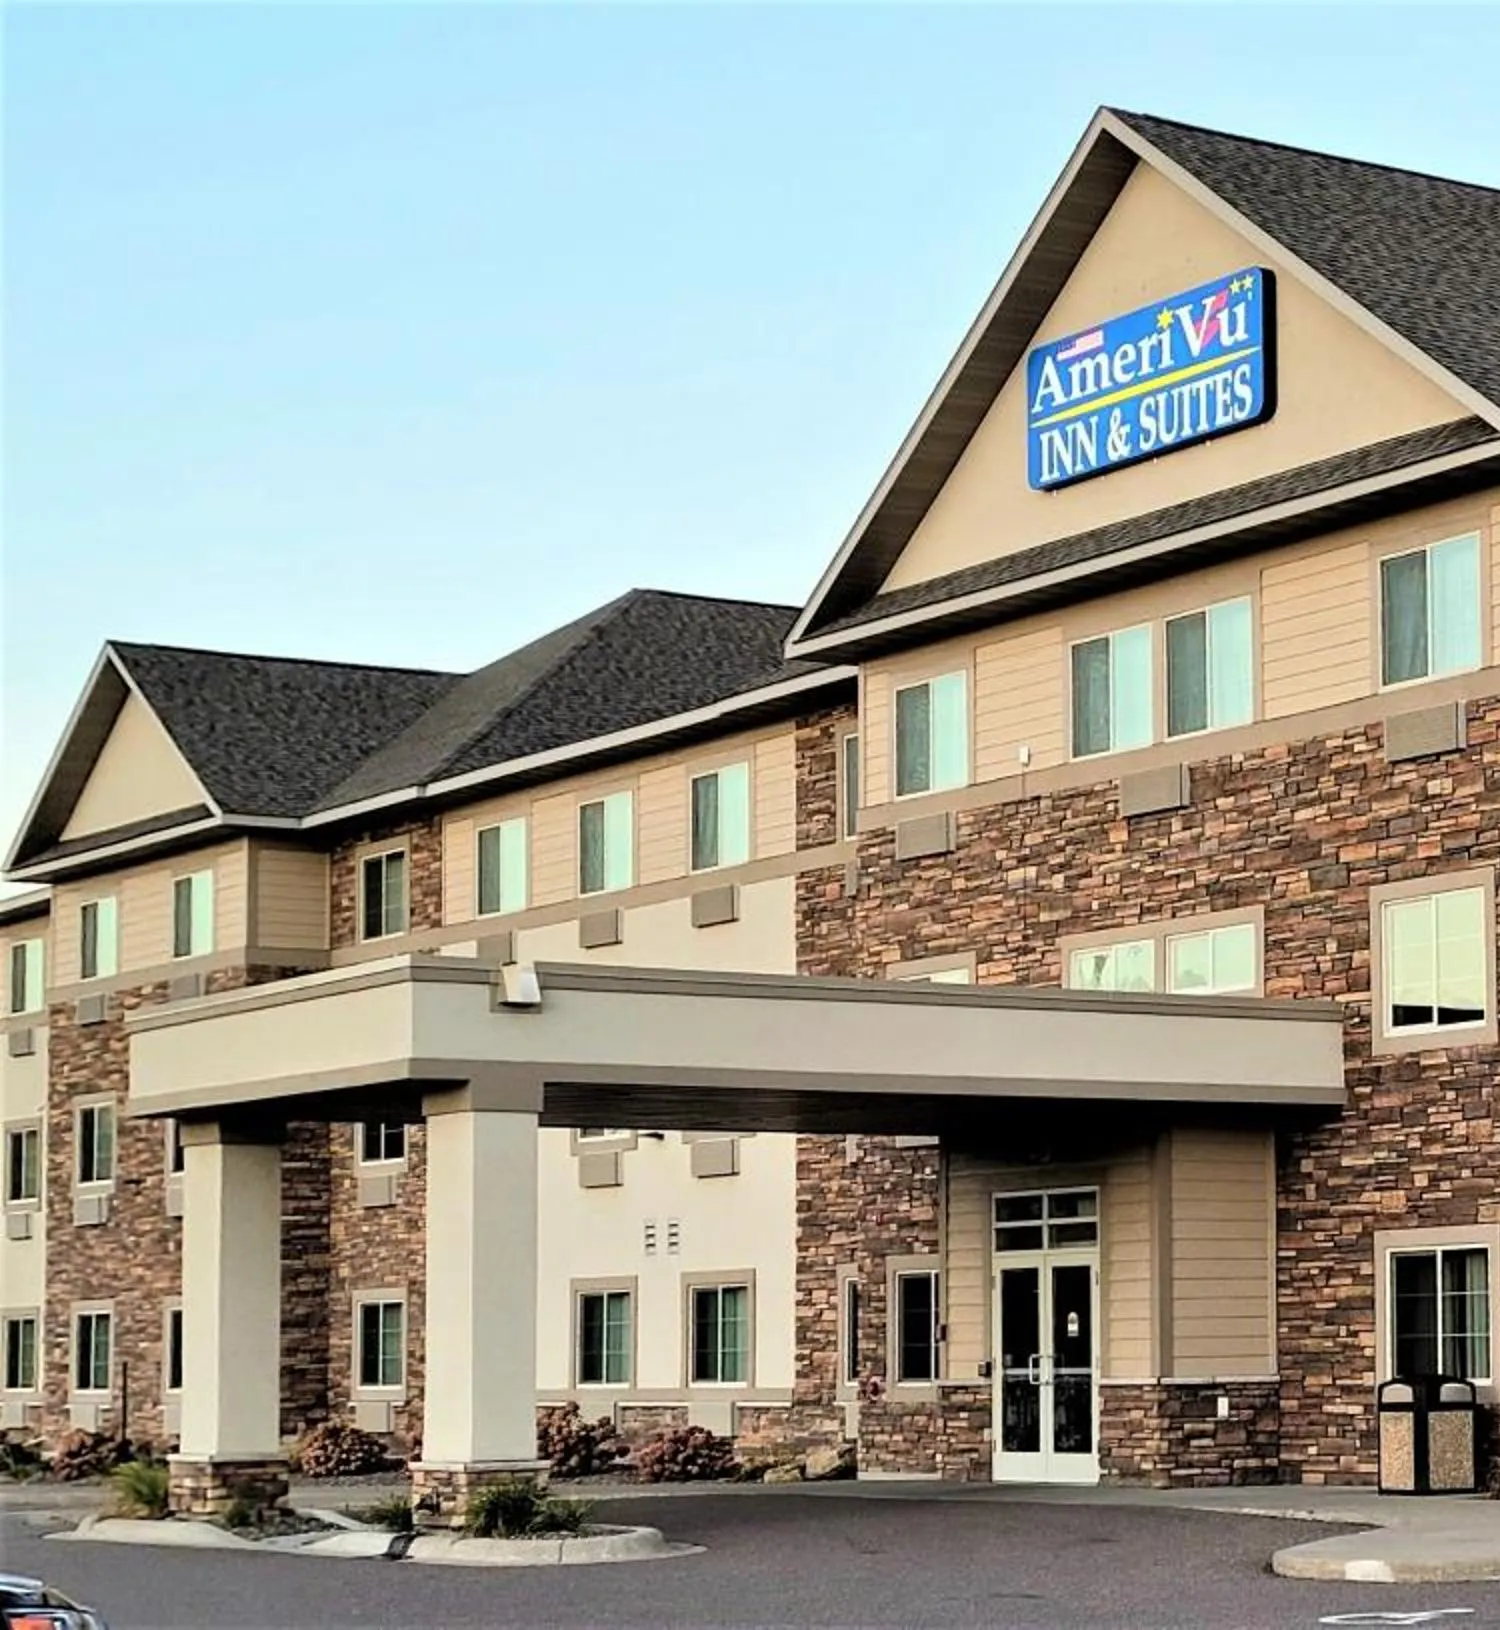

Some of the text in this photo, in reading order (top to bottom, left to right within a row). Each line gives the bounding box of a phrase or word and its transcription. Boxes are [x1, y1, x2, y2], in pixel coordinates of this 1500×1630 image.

[1039, 363, 1253, 483] INN & SUITES
